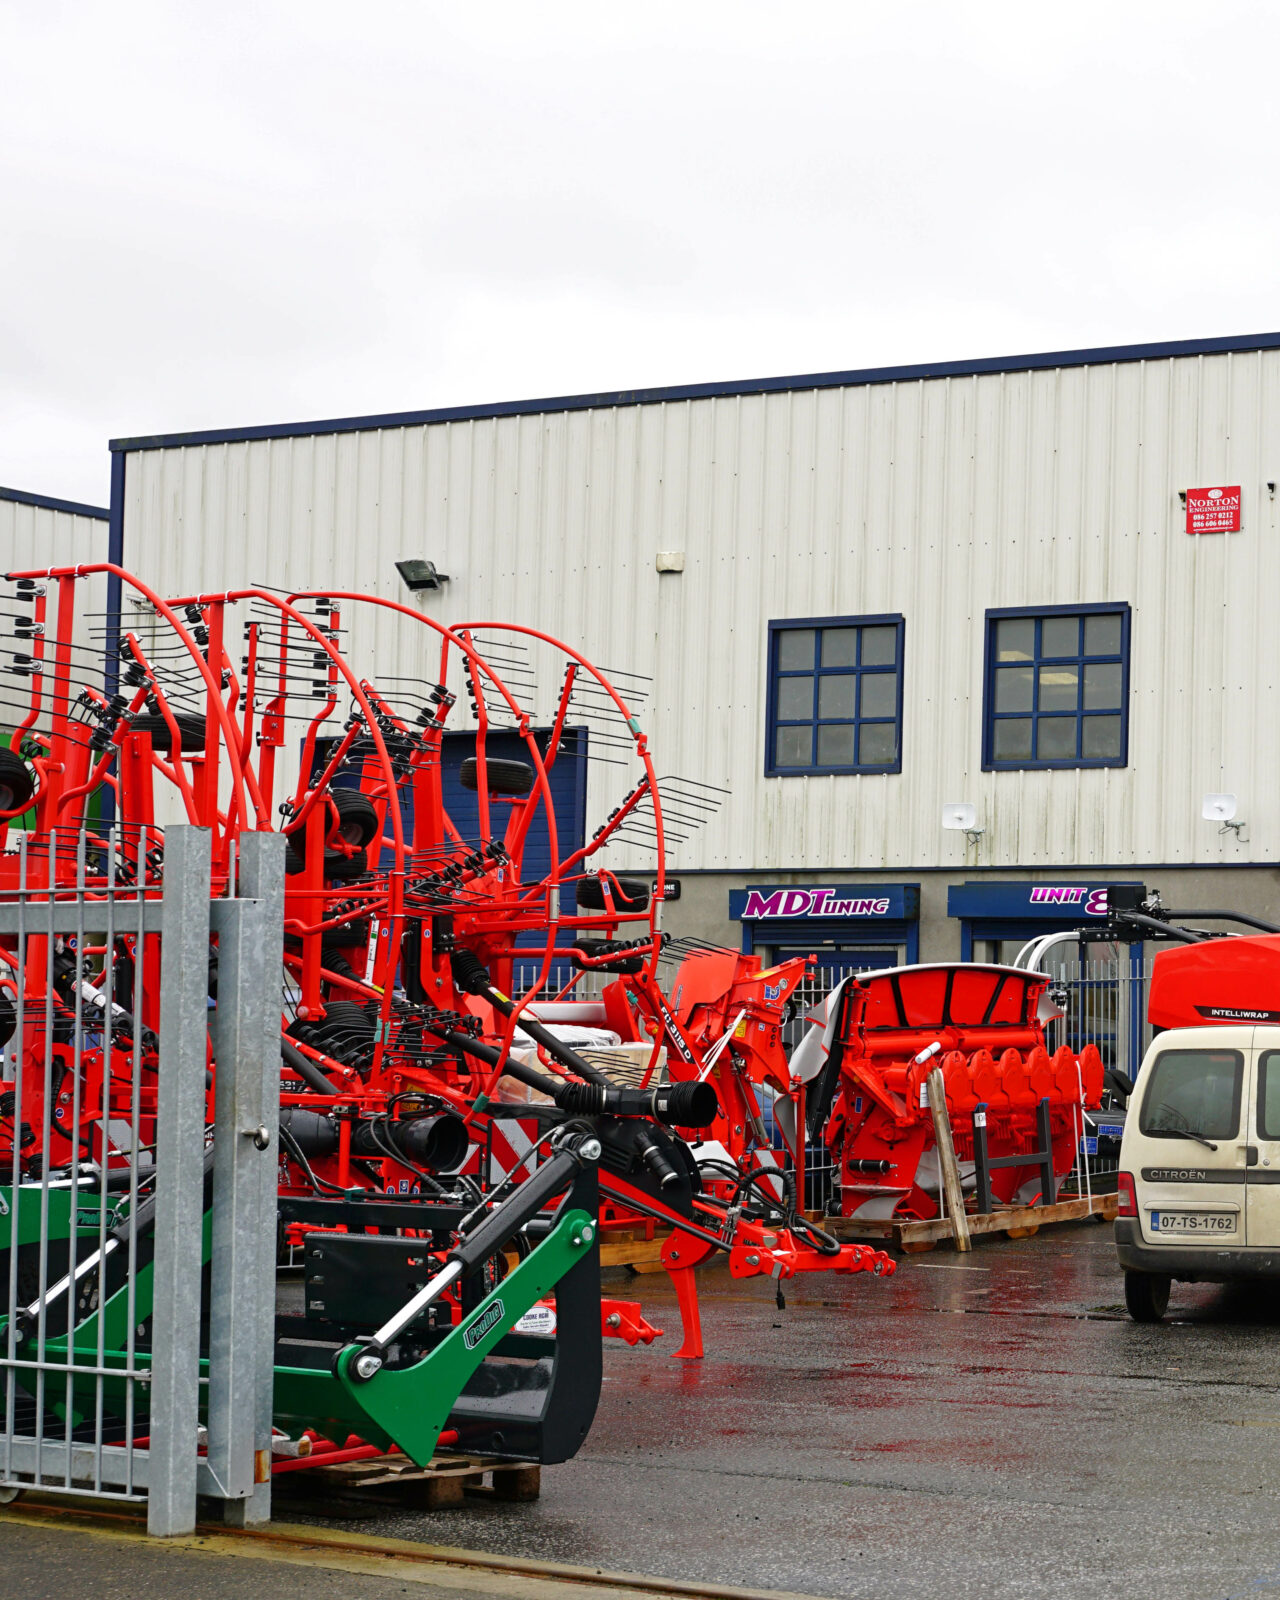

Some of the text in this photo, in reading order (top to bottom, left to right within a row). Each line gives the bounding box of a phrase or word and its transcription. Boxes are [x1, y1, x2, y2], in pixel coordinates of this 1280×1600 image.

[1189, 495, 1239, 507] NORTON
[1189, 505, 1238, 513] ENGINEERING
[1030, 887, 1088, 904] UNIT
[1211, 1009, 1269, 1019] INTELLIWRAP
[670, 1024, 686, 1049] 3115
[684, 1049, 692, 1060] D
[1150, 1168, 1206, 1180] CITROËN
[1162, 1216, 1232, 1229] 07-TS-1762
